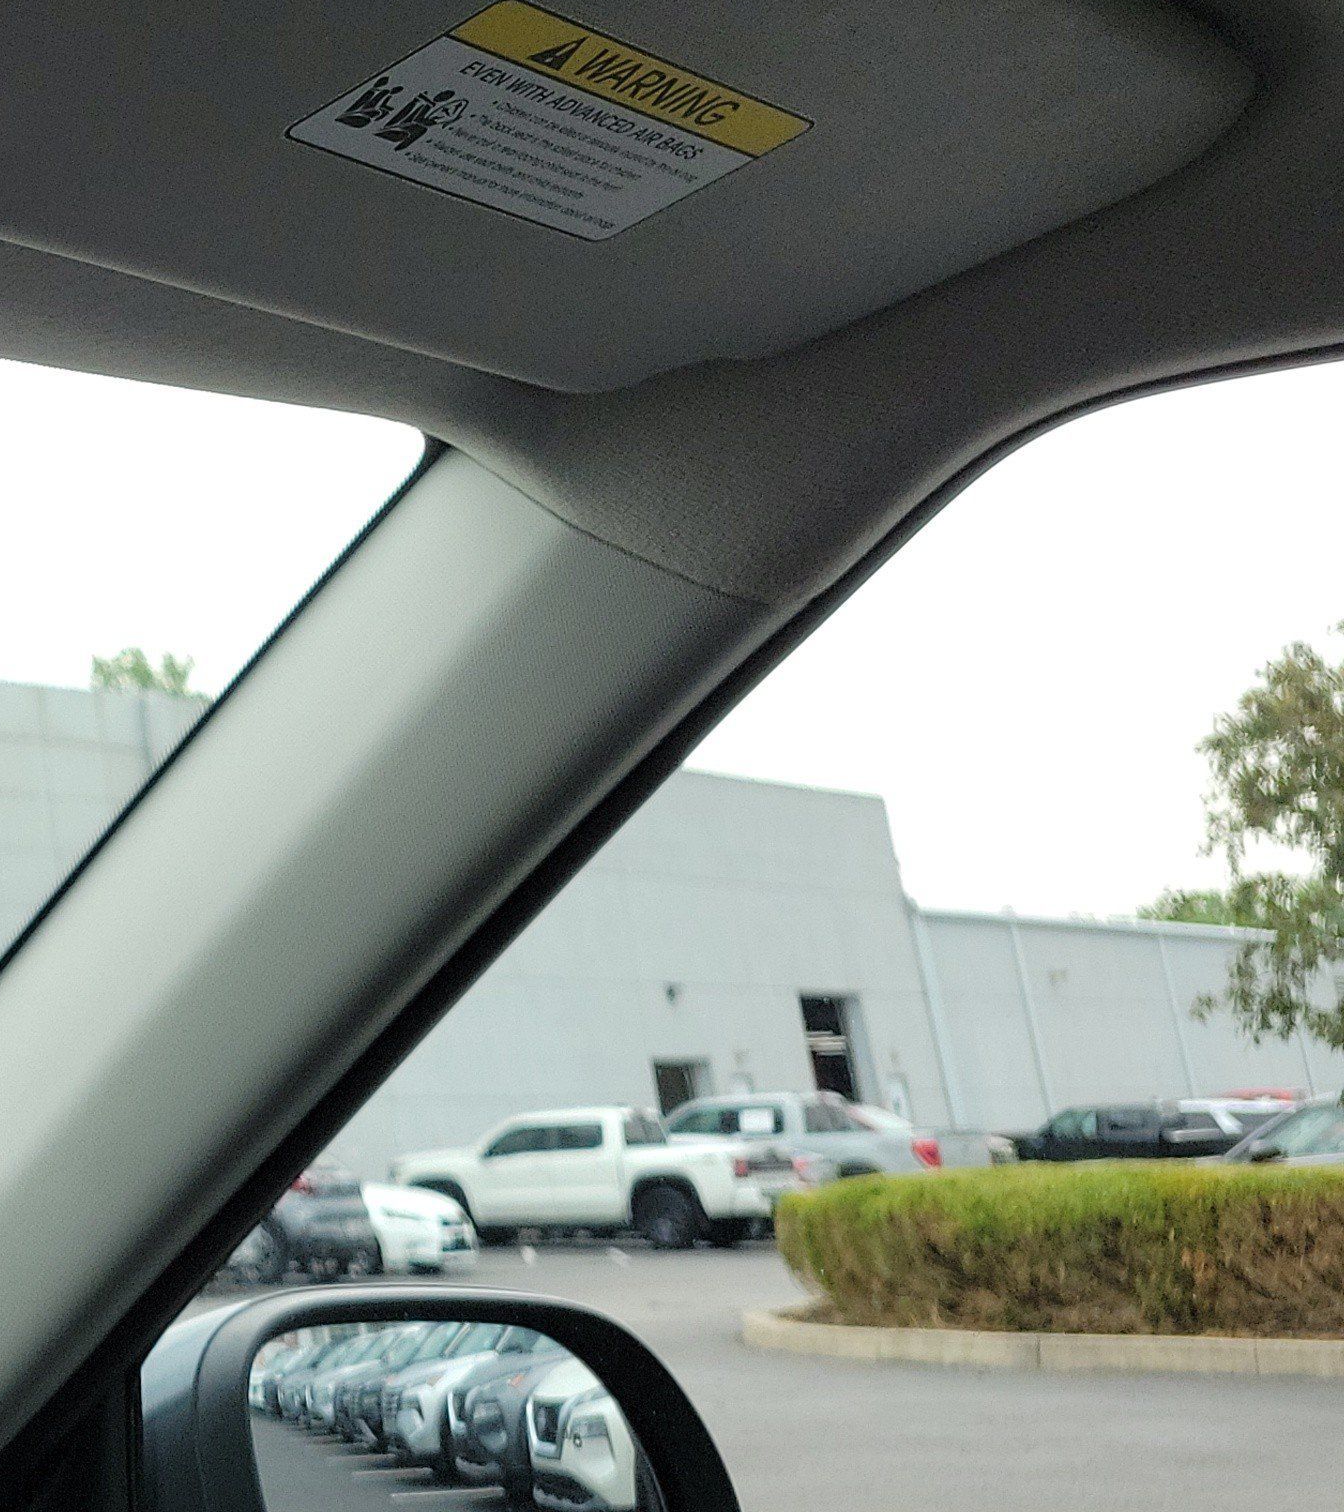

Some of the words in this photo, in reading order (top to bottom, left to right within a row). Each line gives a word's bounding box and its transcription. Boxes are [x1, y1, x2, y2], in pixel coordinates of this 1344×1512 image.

[459, 61, 512, 85] EVEN
[505, 78, 554, 102] WITH
[546, 96, 634, 133] ADVANCED
[627, 128, 663, 144] AIR
[654, 137, 703, 159] BAGS
[574, 50, 740, 126] WARNING
